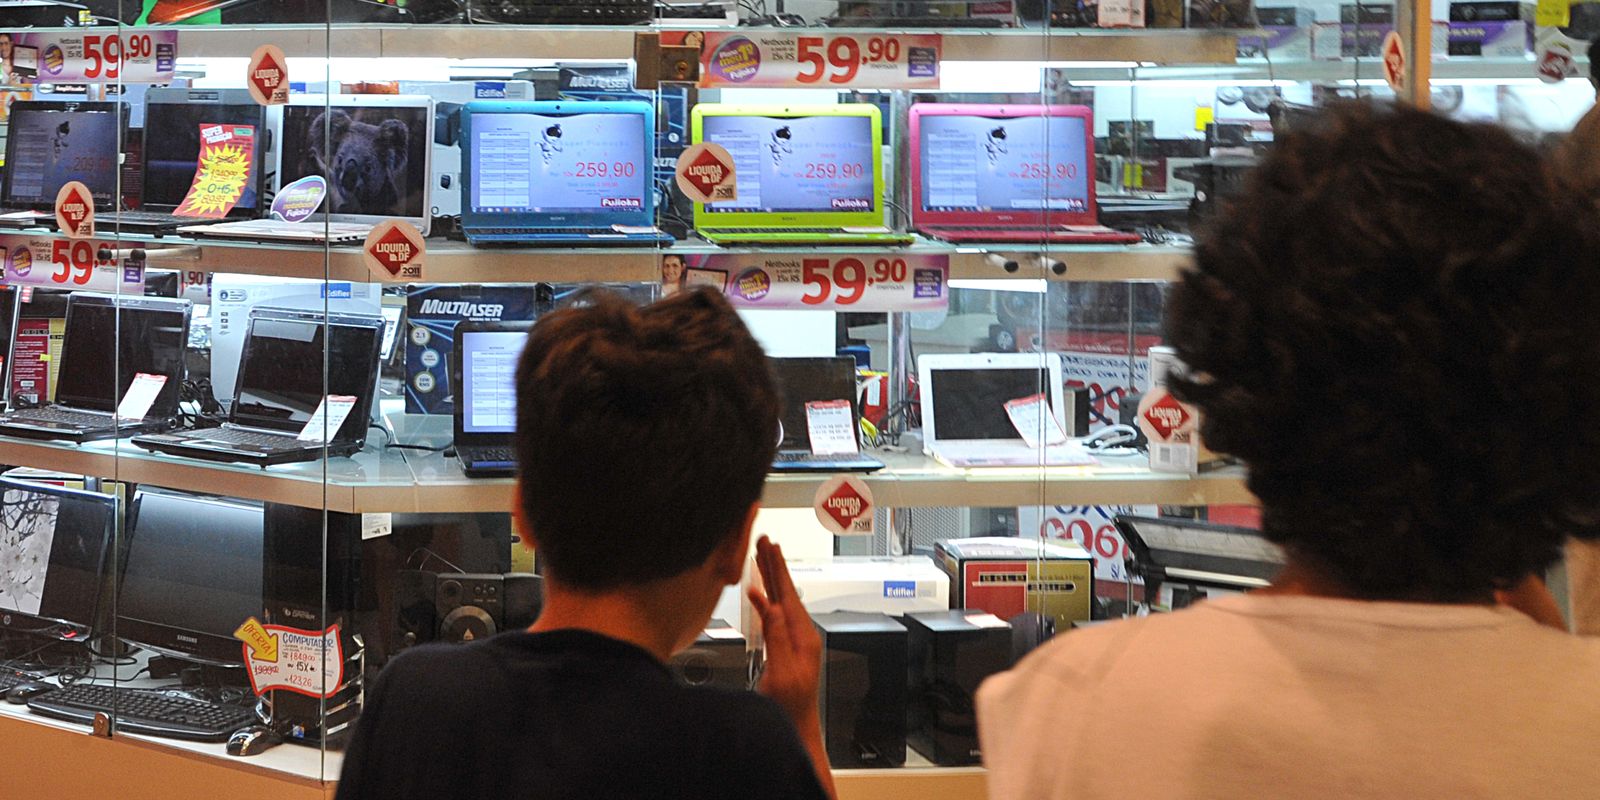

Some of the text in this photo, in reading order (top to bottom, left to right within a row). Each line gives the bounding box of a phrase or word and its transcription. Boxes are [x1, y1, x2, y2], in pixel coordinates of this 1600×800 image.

[796, 37, 901, 84] 59,90
[688, 164, 723, 177] LIQUIDA
[376, 243, 411, 253] LIQUIDA
[398, 252, 410, 262] DF
[402, 266, 421, 275] 2011
[801, 257, 907, 306] 59,90
[420, 299, 504, 318] MULTILASER
[828, 497, 862, 509] LIQUIDA
[849, 506, 861, 517] DF
[854, 520, 870, 529] 2011
